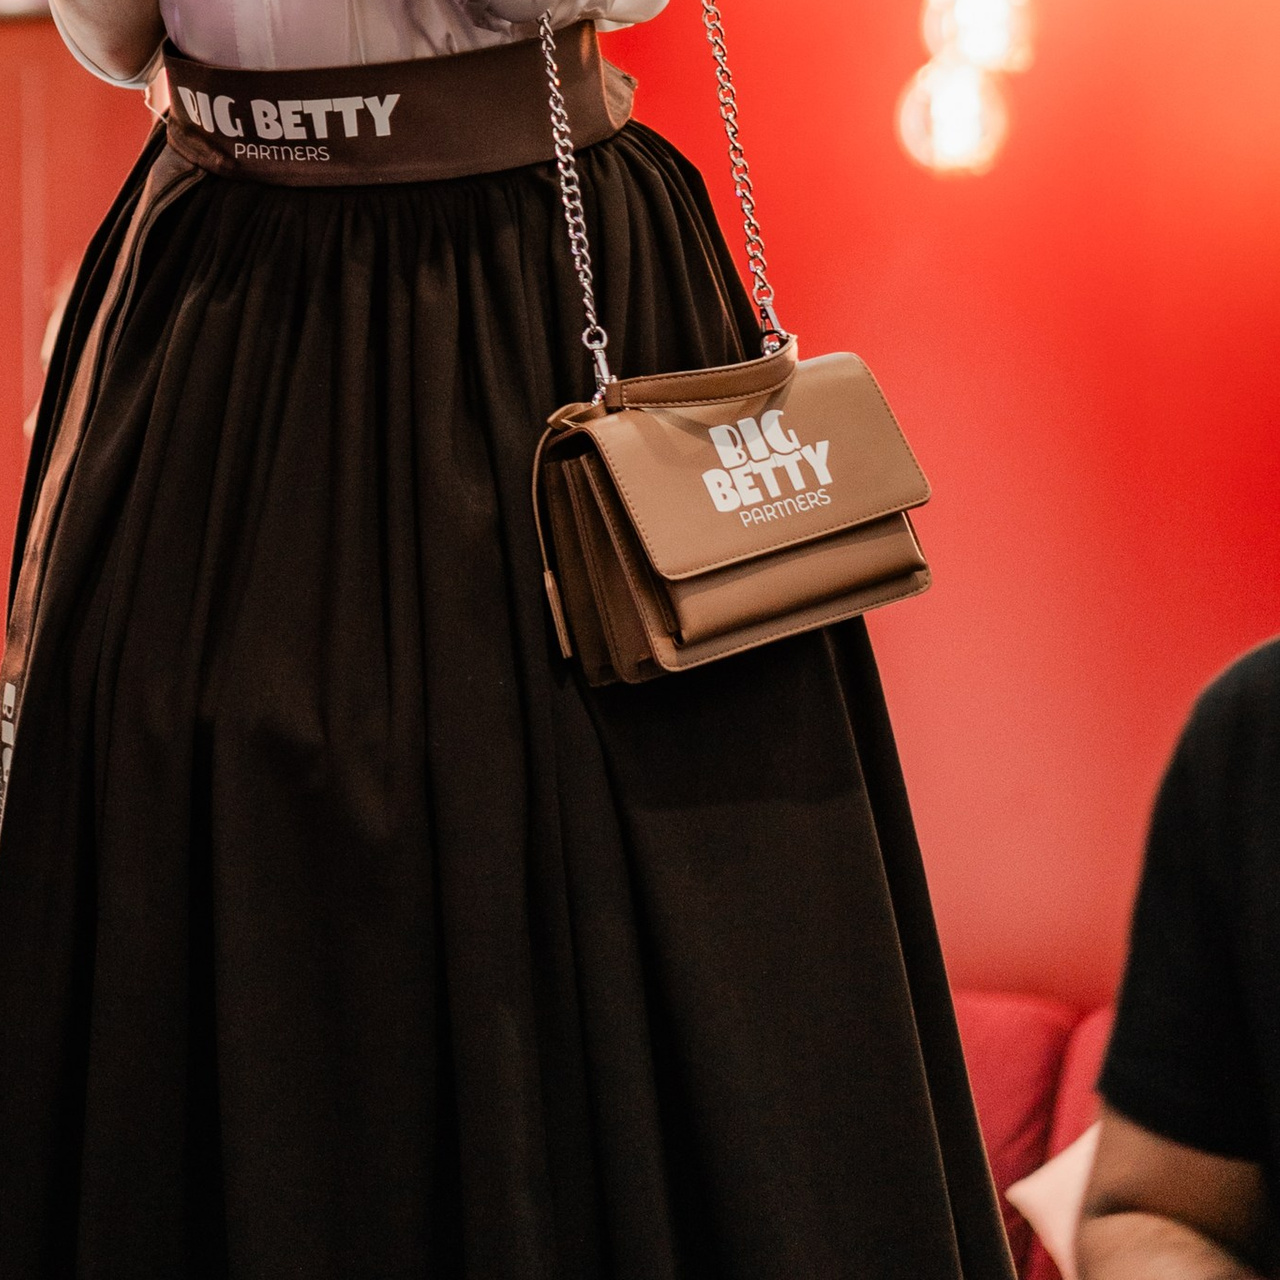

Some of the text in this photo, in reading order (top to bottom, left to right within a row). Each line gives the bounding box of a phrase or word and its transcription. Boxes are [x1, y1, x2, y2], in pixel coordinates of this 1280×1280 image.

[177, 85, 401, 140] BIG BETTY
[234, 143, 330, 162] PARTNERS
[708, 409, 802, 470] BIG
[701, 440, 834, 514] BETTY
[738, 488, 833, 528] PARTNERS
